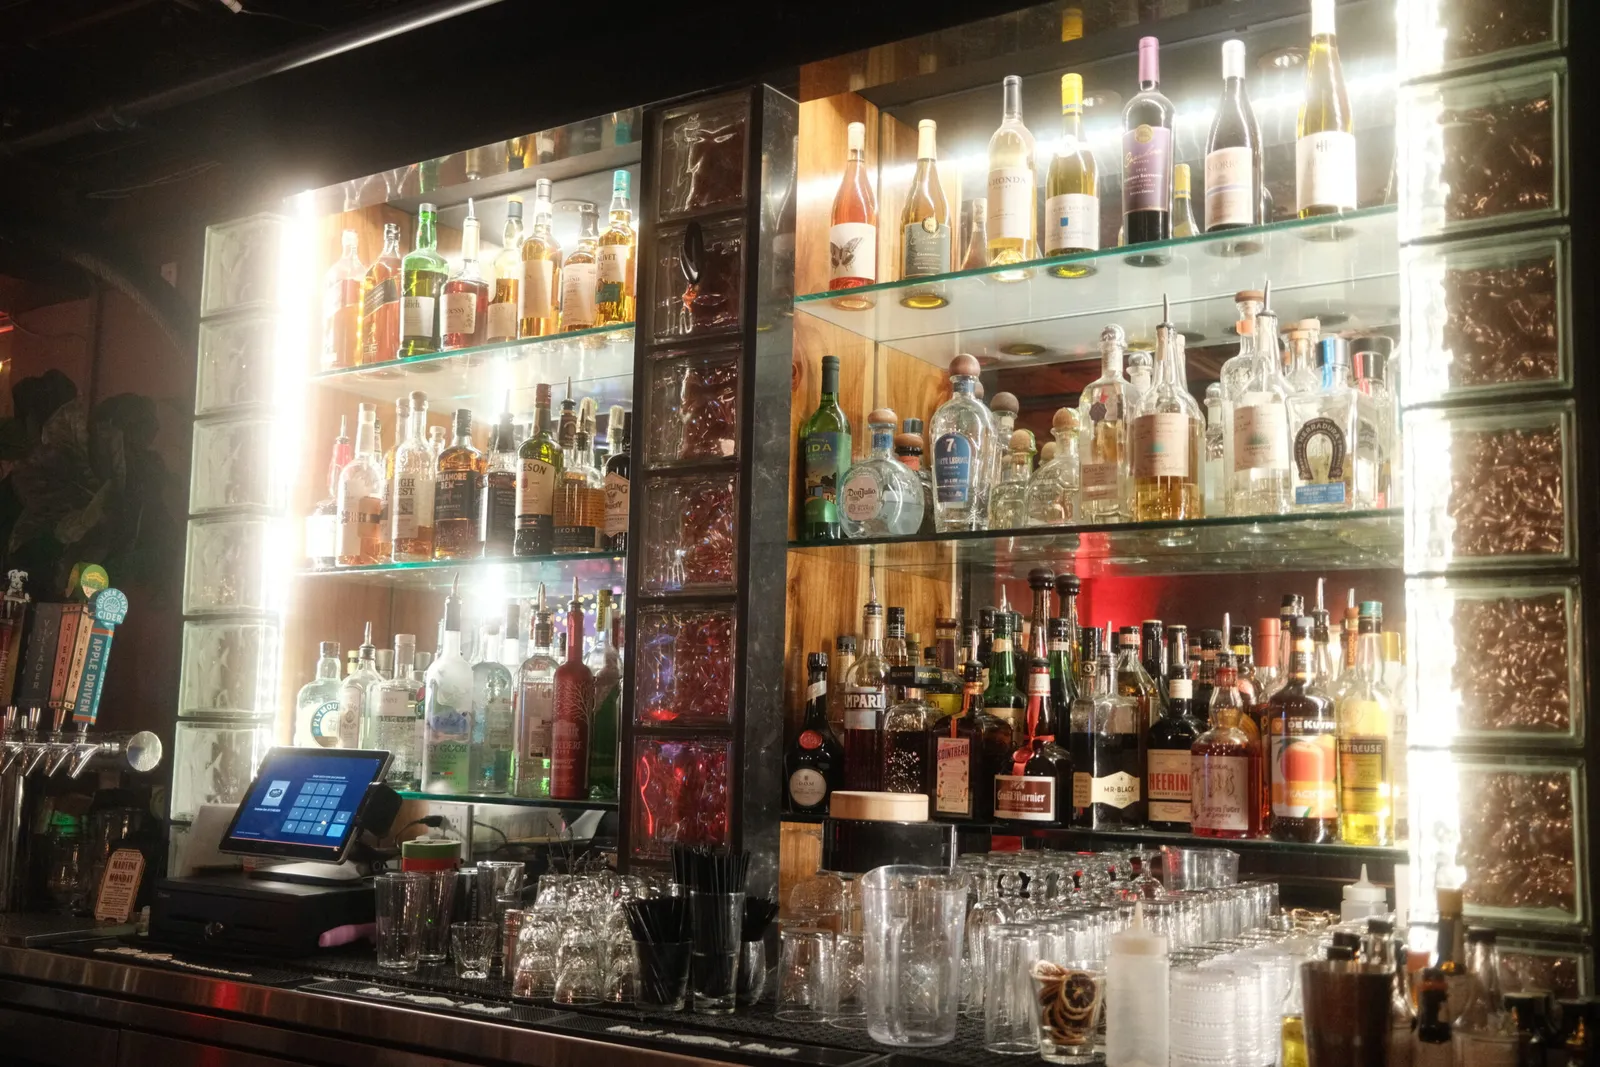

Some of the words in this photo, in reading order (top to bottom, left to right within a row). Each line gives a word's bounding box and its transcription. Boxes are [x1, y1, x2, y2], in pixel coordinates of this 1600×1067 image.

[807, 443, 832, 453] IDA
[521, 463, 547, 476] ESON
[400, 478, 416, 488] GH
[398, 487, 416, 496] EST
[97, 590, 117, 609] GOLDEN
[98, 611, 123, 623] CIDER
[33, 620, 51, 689] VILLAGER
[88, 638, 103, 670] APPLE
[80, 674, 96, 713] DRIVEN
[312, 703, 340, 727] PLYMOU
[938, 745, 969, 760] COINTREAU
